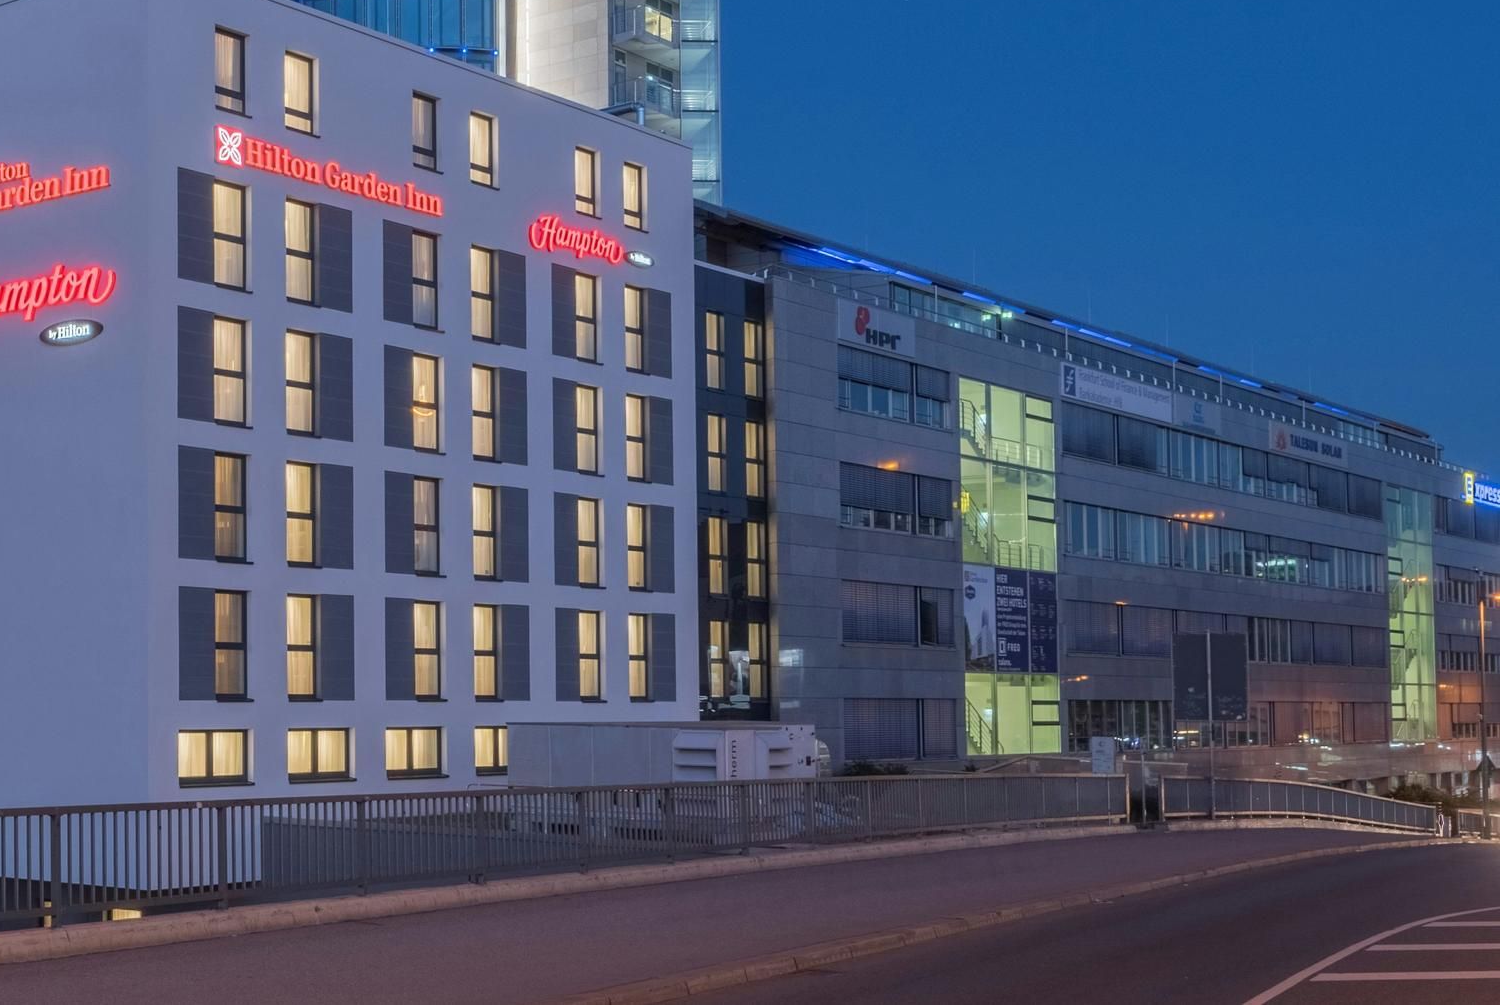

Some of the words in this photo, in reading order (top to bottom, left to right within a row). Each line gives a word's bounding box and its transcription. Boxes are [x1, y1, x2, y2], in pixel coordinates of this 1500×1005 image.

[63, 165, 110, 195] Inn
[245, 138, 322, 184] Hilton
[323, 161, 402, 205] Garden
[405, 182, 442, 216] Inn
[529, 215, 623, 265] Hampton
[48, 329, 57, 340] by
[57, 323, 90, 339] Hilton
